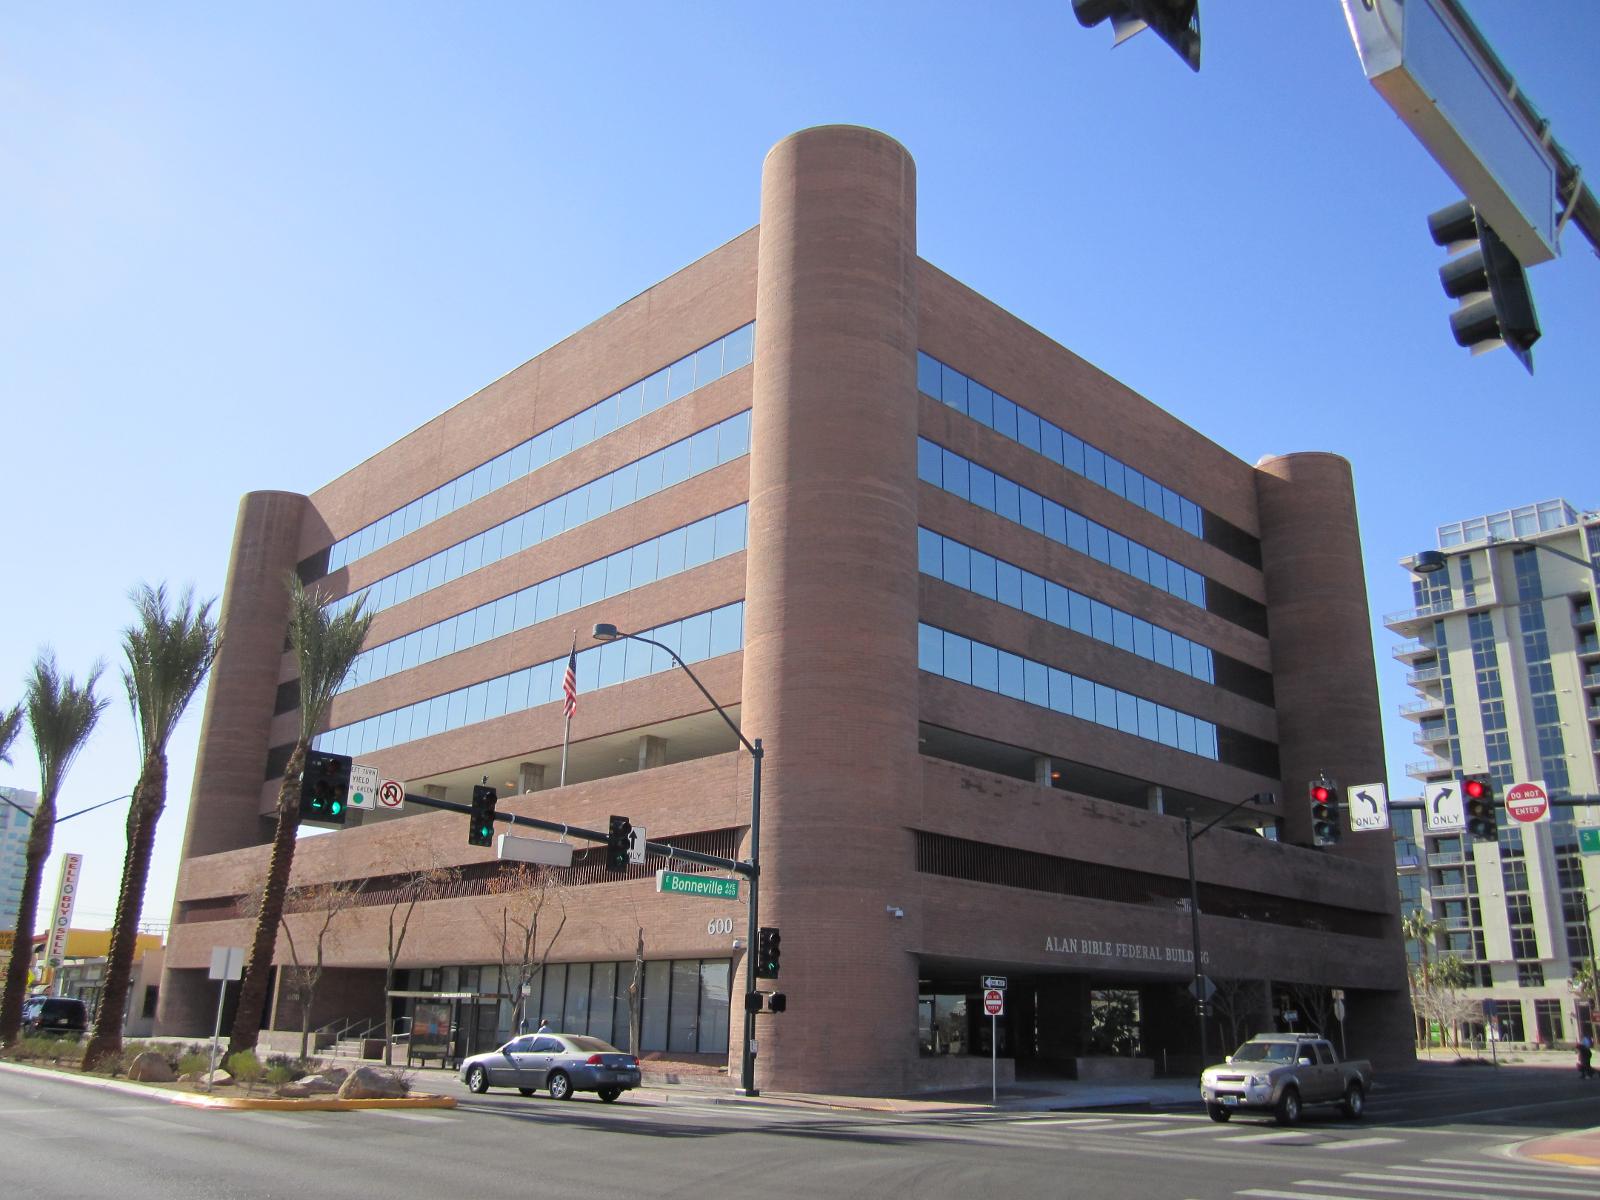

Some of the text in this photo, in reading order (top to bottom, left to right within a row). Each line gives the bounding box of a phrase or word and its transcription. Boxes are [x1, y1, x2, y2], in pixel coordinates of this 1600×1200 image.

[353, 776, 369, 784] YIELD
[1510, 789, 1540, 800] DO NOT
[1515, 806, 1540, 816] ENTER
[1356, 815, 1381, 827] ONLY
[1433, 814, 1460, 825] ONLY
[671, 876, 723, 895] Bonneville
[53, 856, 78, 954] SELL BUY SELL
[708, 918, 733, 935] 600
[1045, 936, 1209, 965] ALAN BIBLE FEDERAL BUILDG
